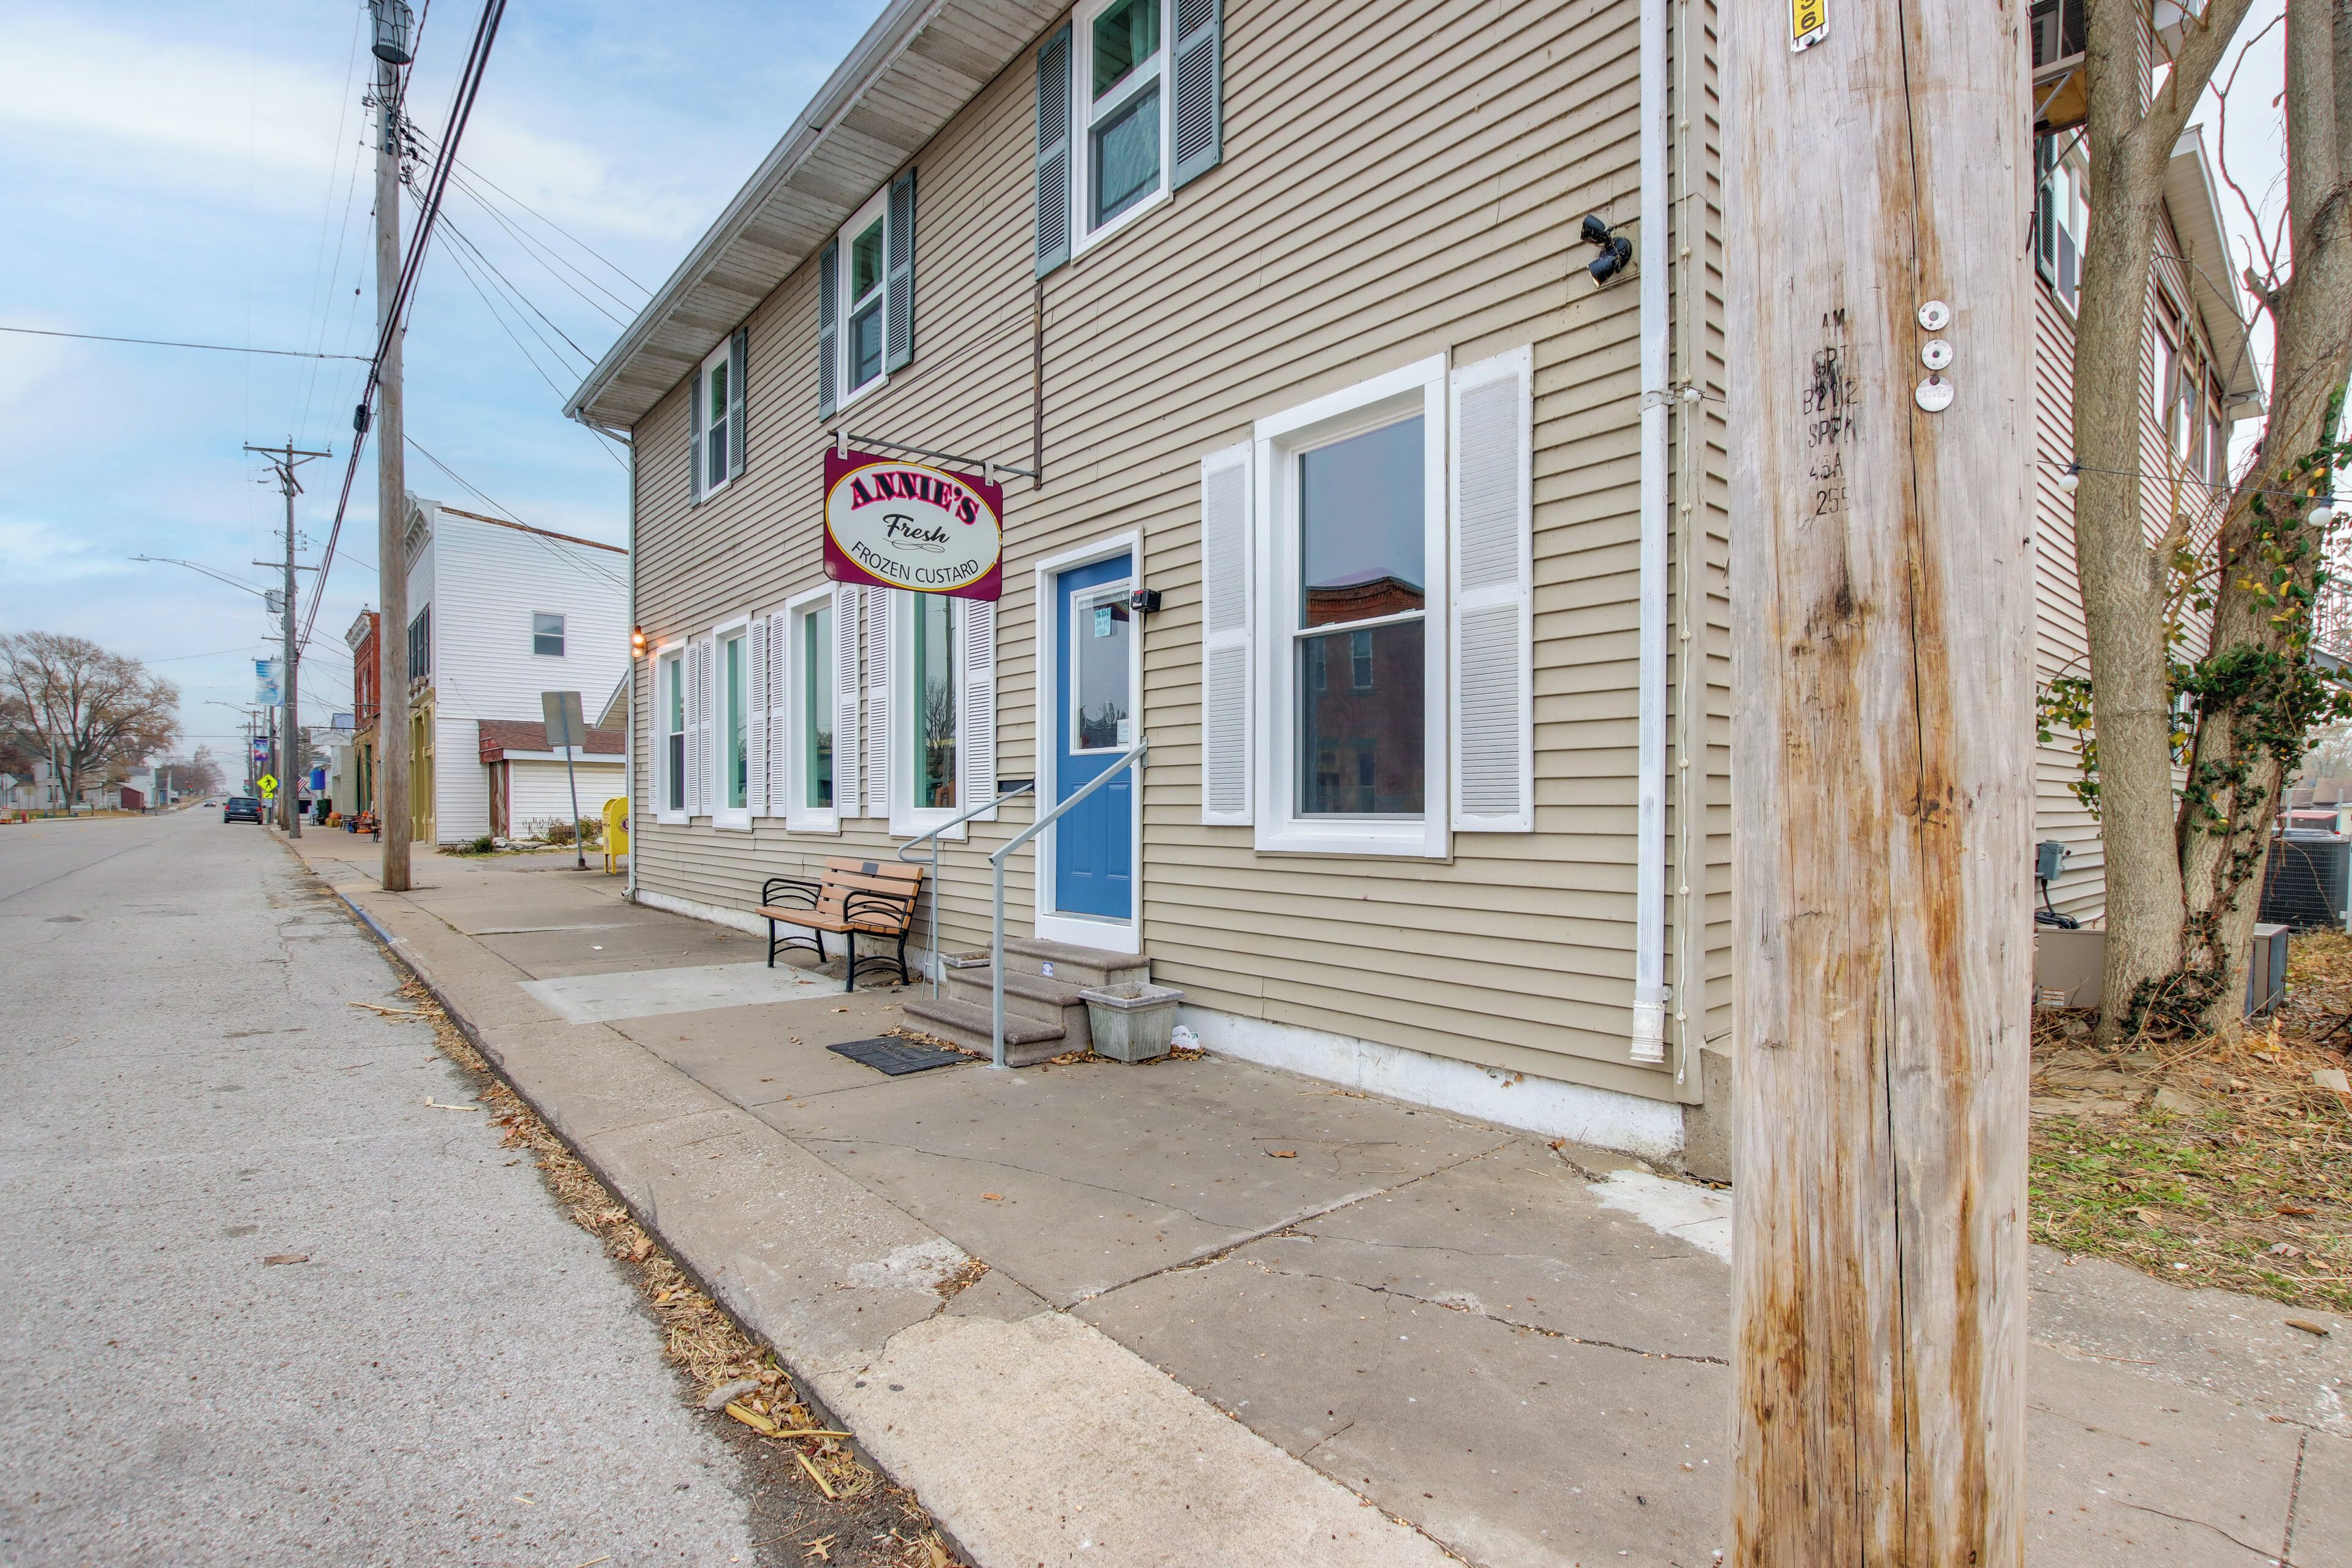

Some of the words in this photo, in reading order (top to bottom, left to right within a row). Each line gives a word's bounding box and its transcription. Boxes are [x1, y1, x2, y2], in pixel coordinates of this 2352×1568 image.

[850, 470, 980, 526] ANNIE'S
[883, 513, 951, 543] Fresh
[851, 541, 910, 580] FROZEN
[915, 559, 979, 583] CUSTARD
